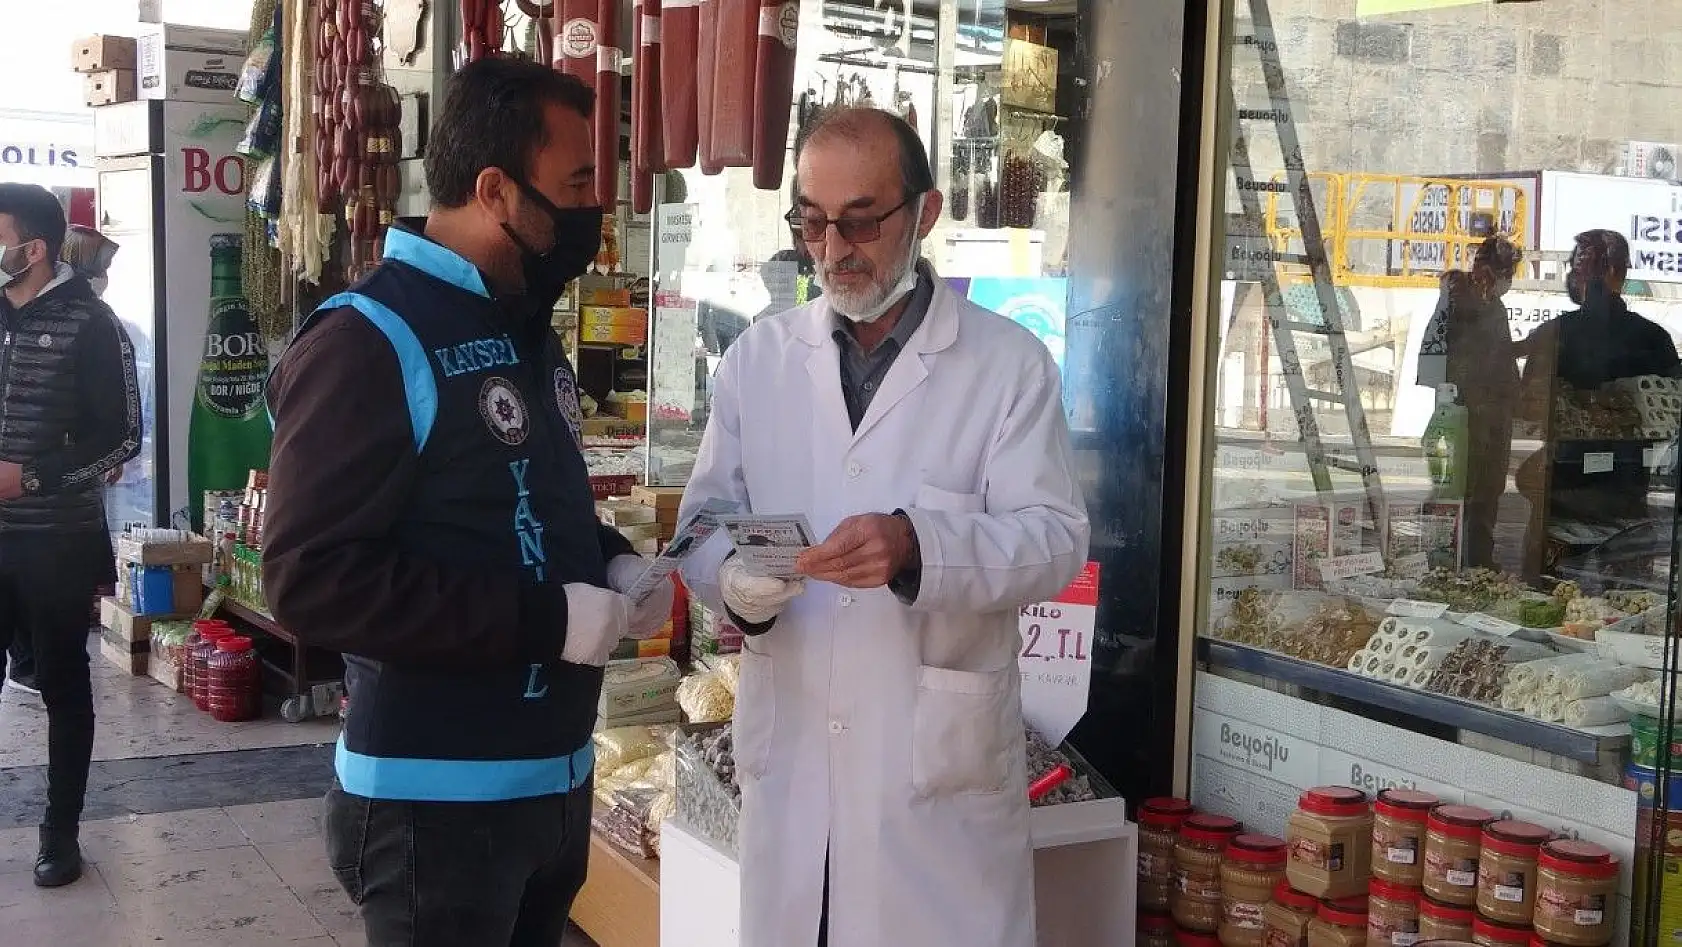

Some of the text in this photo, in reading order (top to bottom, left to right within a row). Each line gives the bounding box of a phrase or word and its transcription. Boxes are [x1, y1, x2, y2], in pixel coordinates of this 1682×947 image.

[181, 148, 245, 195] BO
[206, 332, 264, 357] BOR
[1220, 722, 1289, 773] Beyoğlu
